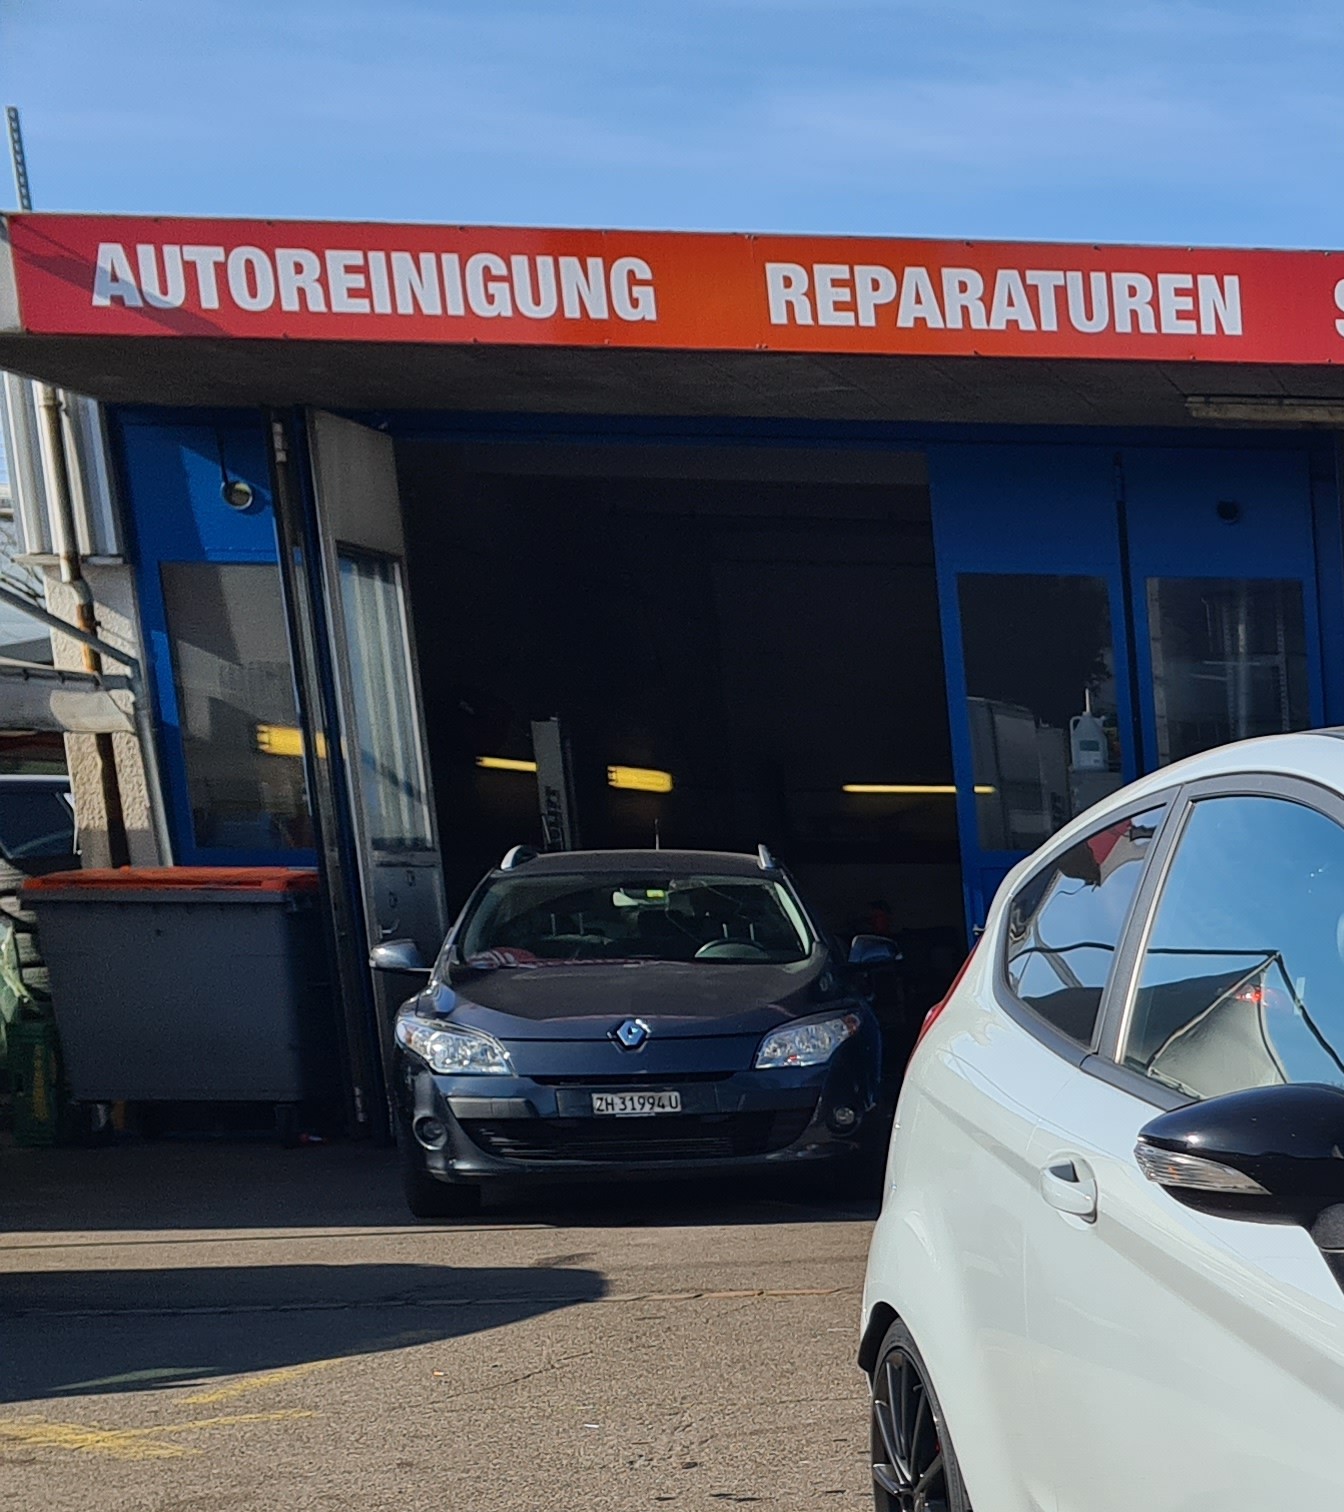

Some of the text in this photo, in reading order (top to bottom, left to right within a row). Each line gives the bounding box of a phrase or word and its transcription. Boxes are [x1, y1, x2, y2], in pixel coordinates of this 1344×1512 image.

[92, 242, 657, 322] AUTOREINIGUNG
[765, 262, 1242, 336] REPARATUREN
[595, 1096, 615, 1112] ZH
[618, 1095, 666, 1112] 31994
